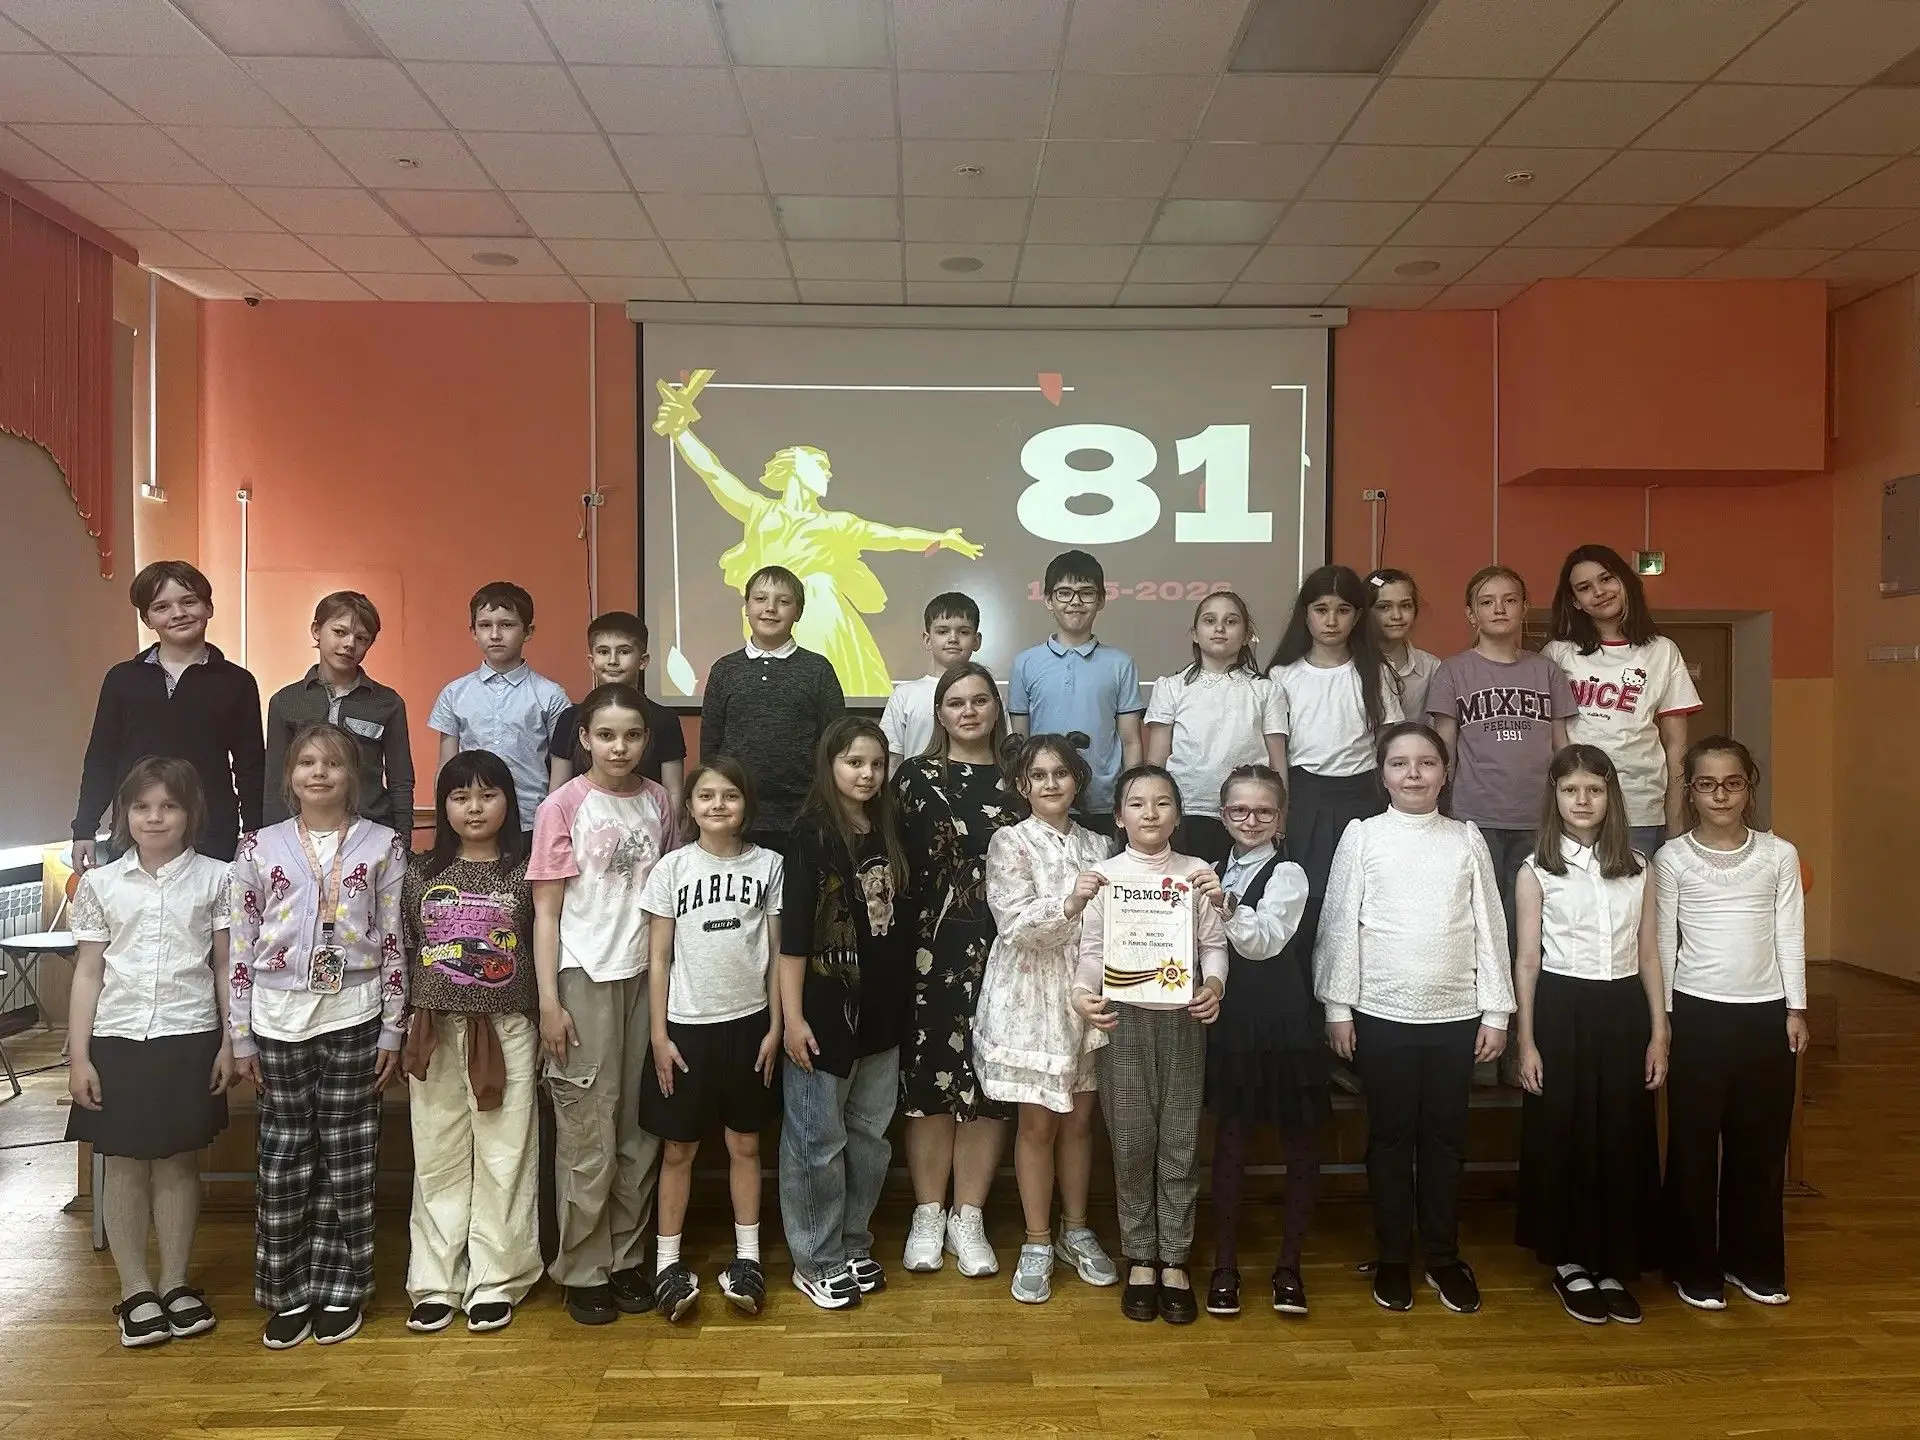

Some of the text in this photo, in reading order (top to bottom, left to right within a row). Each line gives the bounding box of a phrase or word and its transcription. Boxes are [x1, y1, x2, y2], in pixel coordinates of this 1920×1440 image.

[1017, 424, 1272, 544] 81
[1028, 580, 1232, 601] 15-2026
[1456, 687, 1551, 728] MIXED
[1483, 720, 1532, 732] FEELINGS
[1496, 730, 1523, 742] 1991
[676, 873, 769, 919] HARLEM
[1113, 885, 1181, 902] Грамота
